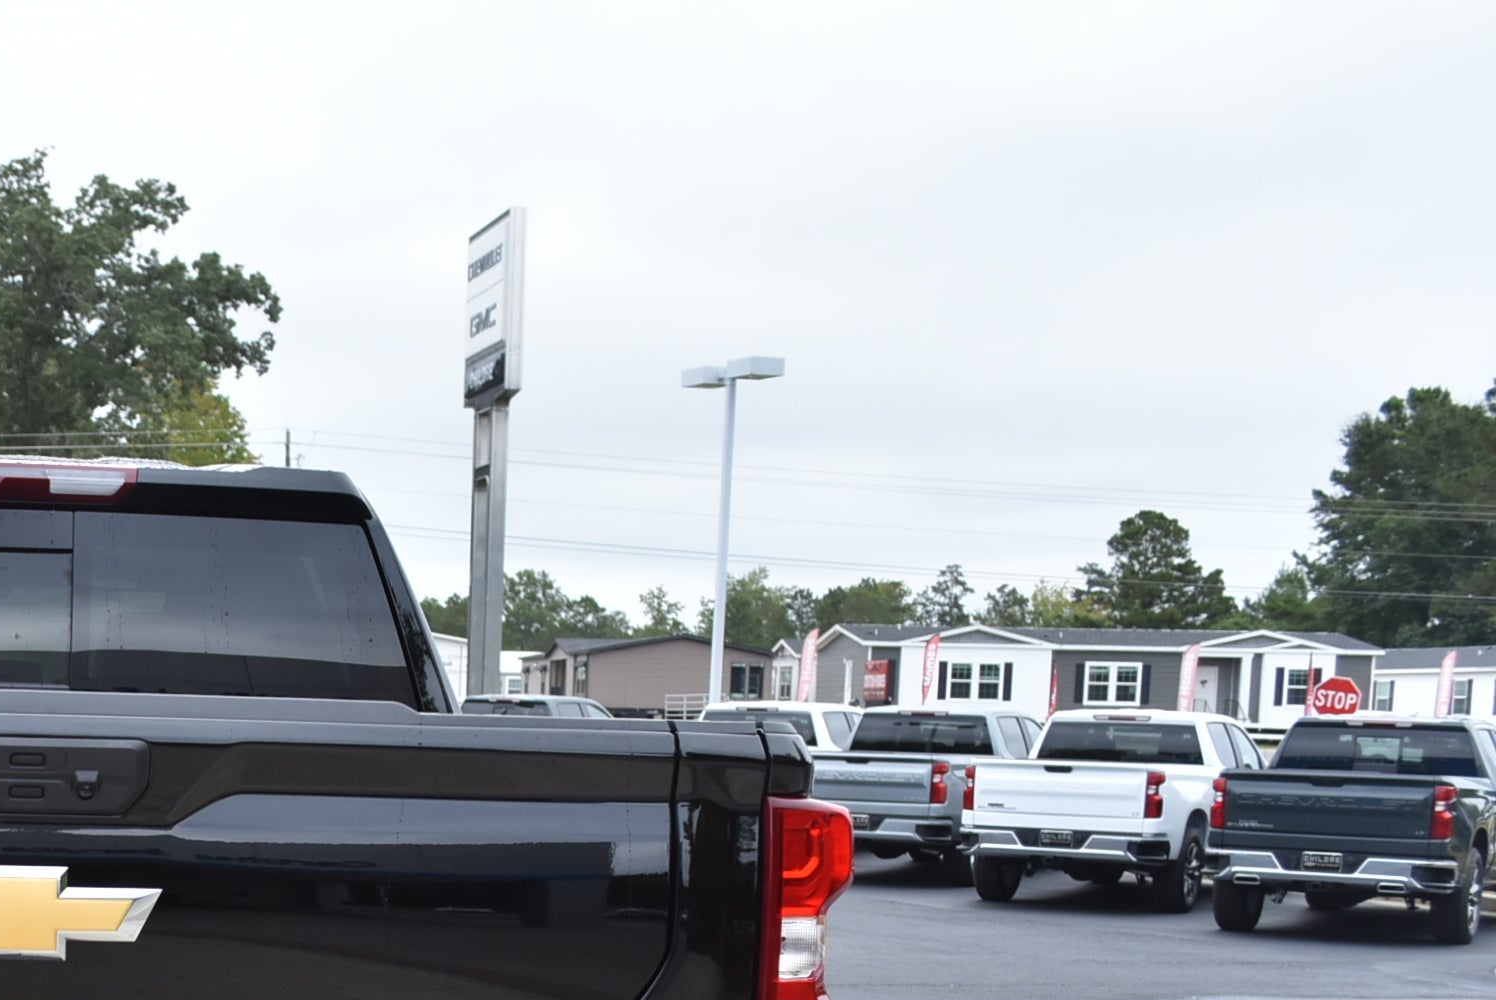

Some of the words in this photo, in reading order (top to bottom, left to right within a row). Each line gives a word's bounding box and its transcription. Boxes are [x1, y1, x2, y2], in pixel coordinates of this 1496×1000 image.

[468, 242, 503, 282] CHEVROLET
[470, 303, 497, 338] GMC
[1315, 689, 1357, 710] STOP
